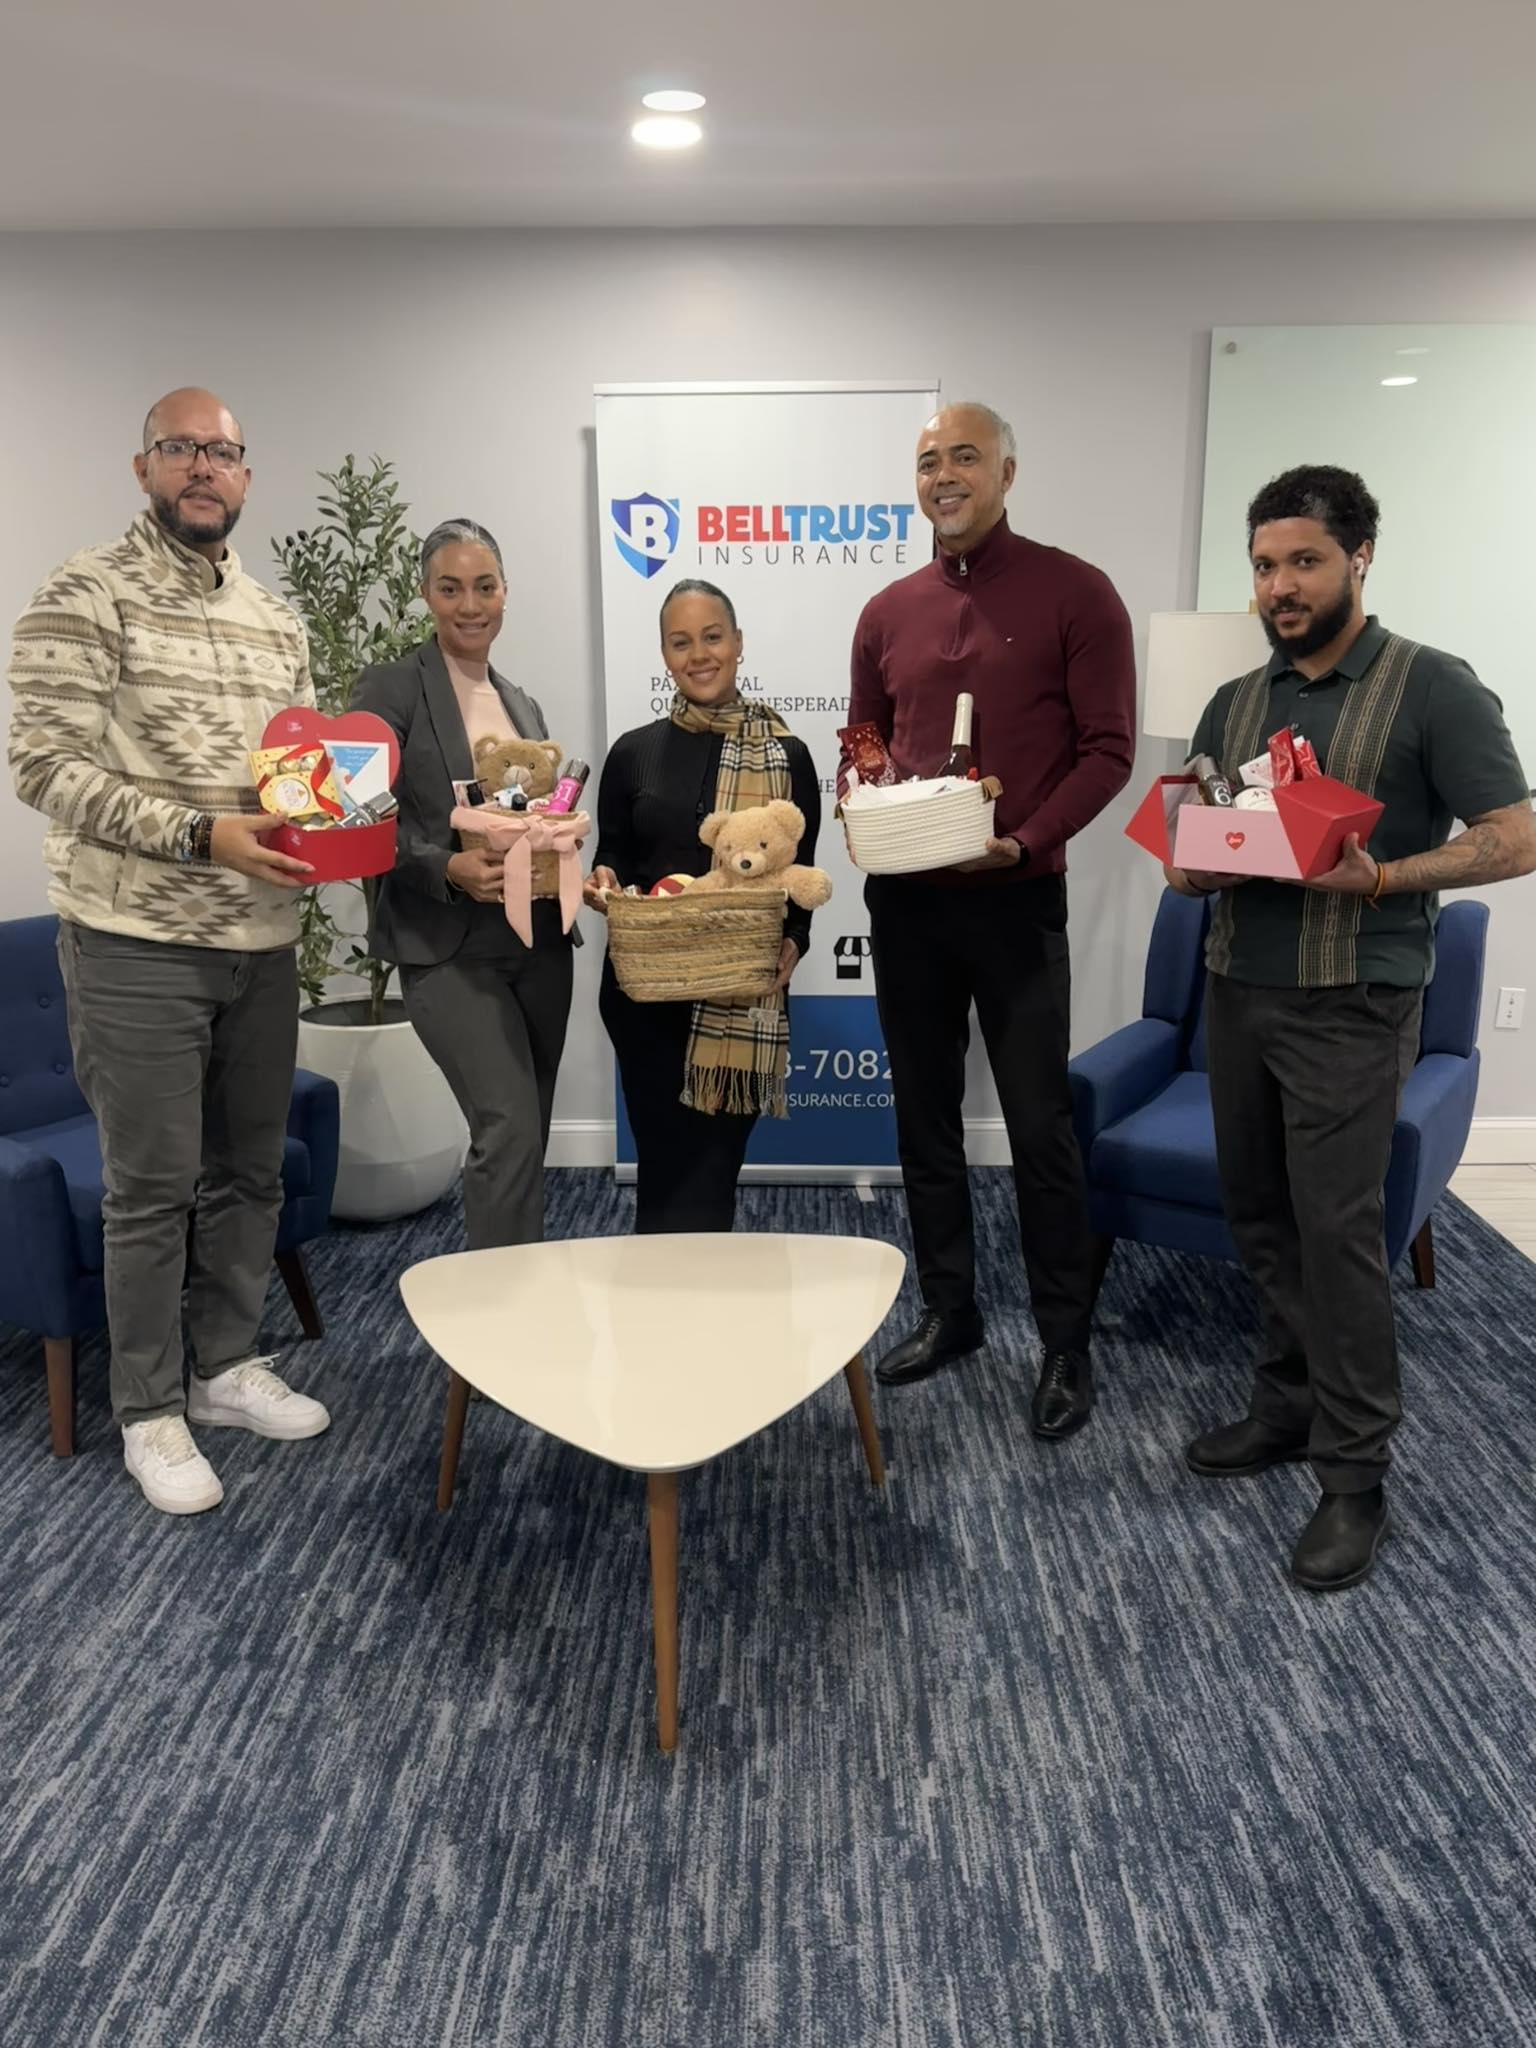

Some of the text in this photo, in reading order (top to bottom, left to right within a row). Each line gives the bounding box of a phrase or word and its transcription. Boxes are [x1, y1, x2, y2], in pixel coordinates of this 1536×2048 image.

[630, 504, 672, 559] B
[698, 504, 915, 543] BELLTRUST
[698, 544, 907, 565] INSURANCE
[651, 677, 679, 691] PA
[752, 696, 851, 712] ESPERAD
[783, 1093, 896, 1108] SURANCE.CO
